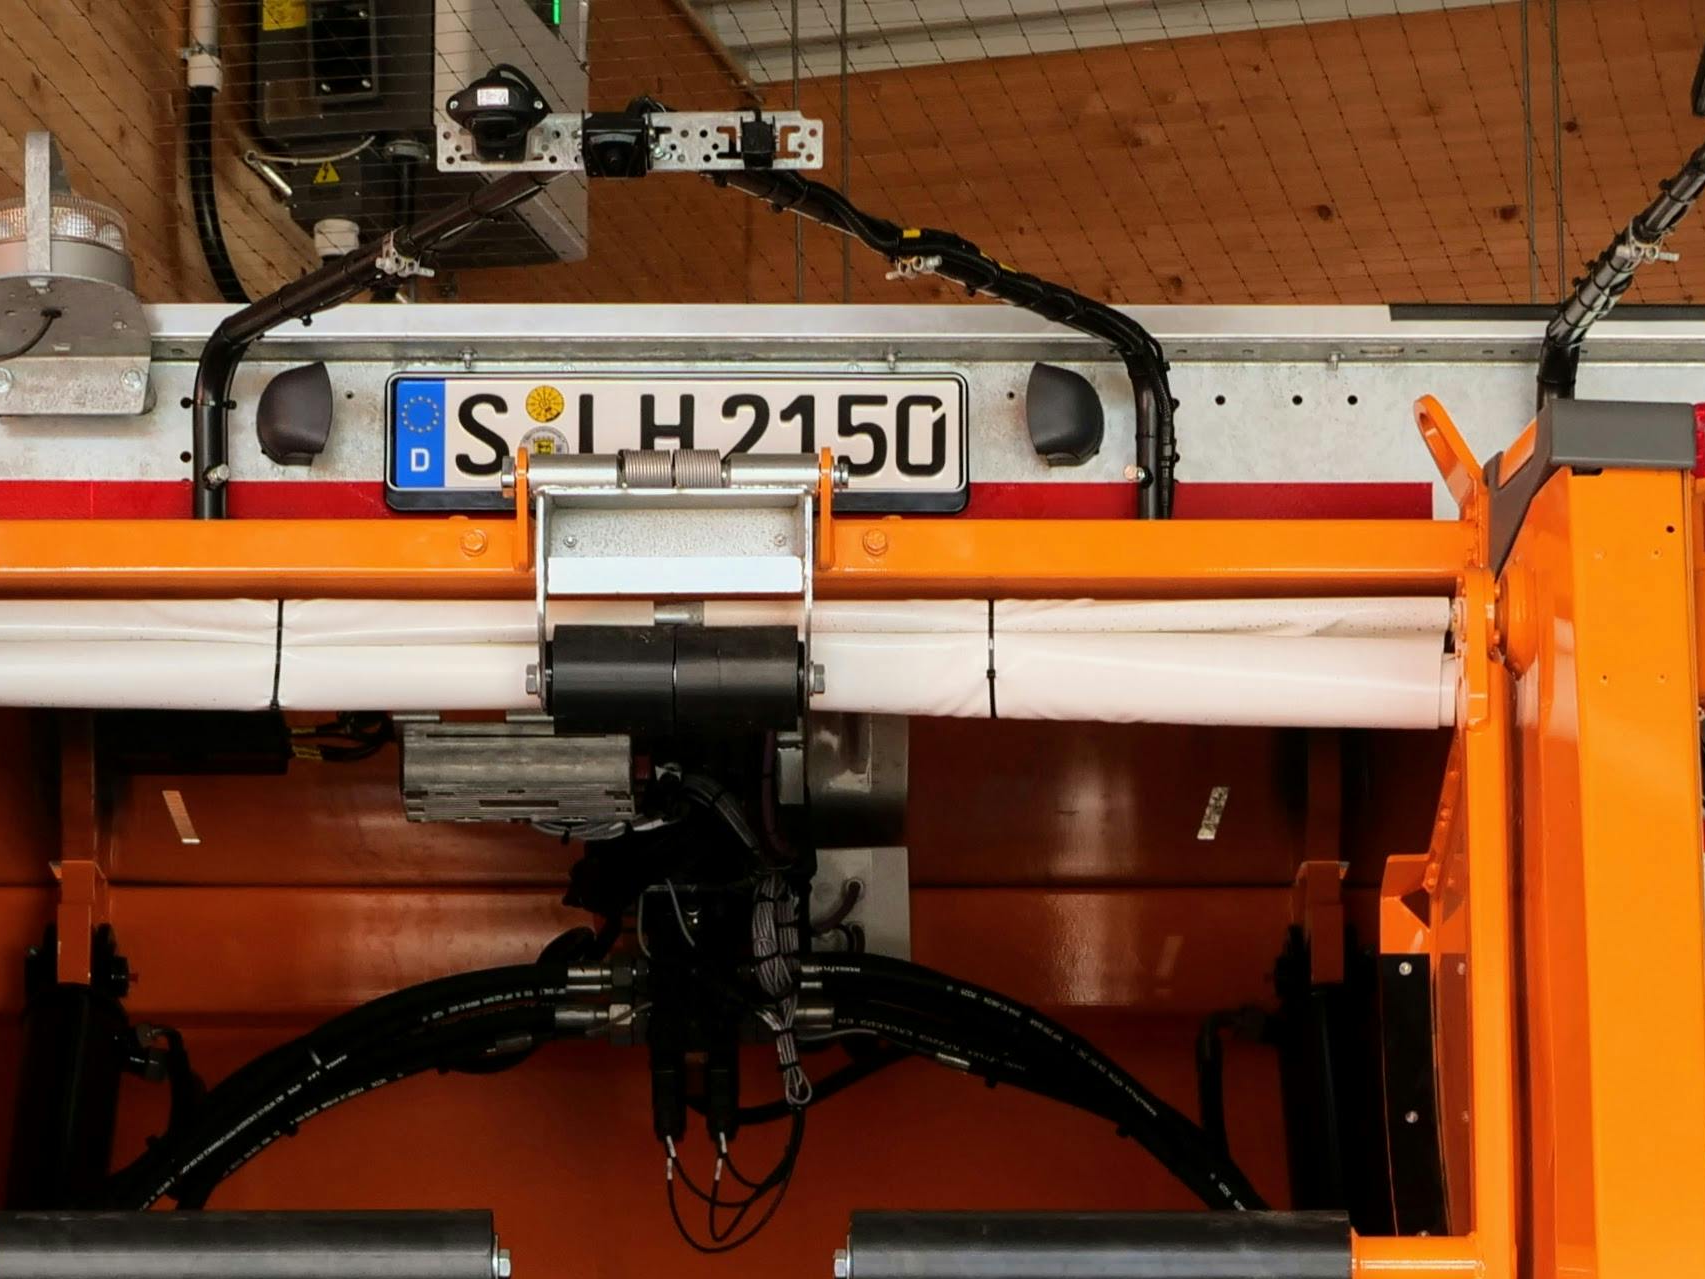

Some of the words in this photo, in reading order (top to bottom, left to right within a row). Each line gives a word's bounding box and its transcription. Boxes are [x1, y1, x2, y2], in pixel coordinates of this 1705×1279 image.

[410, 448, 430, 474] D
[455, 393, 509, 477] S
[721, 394, 947, 477] 2150
